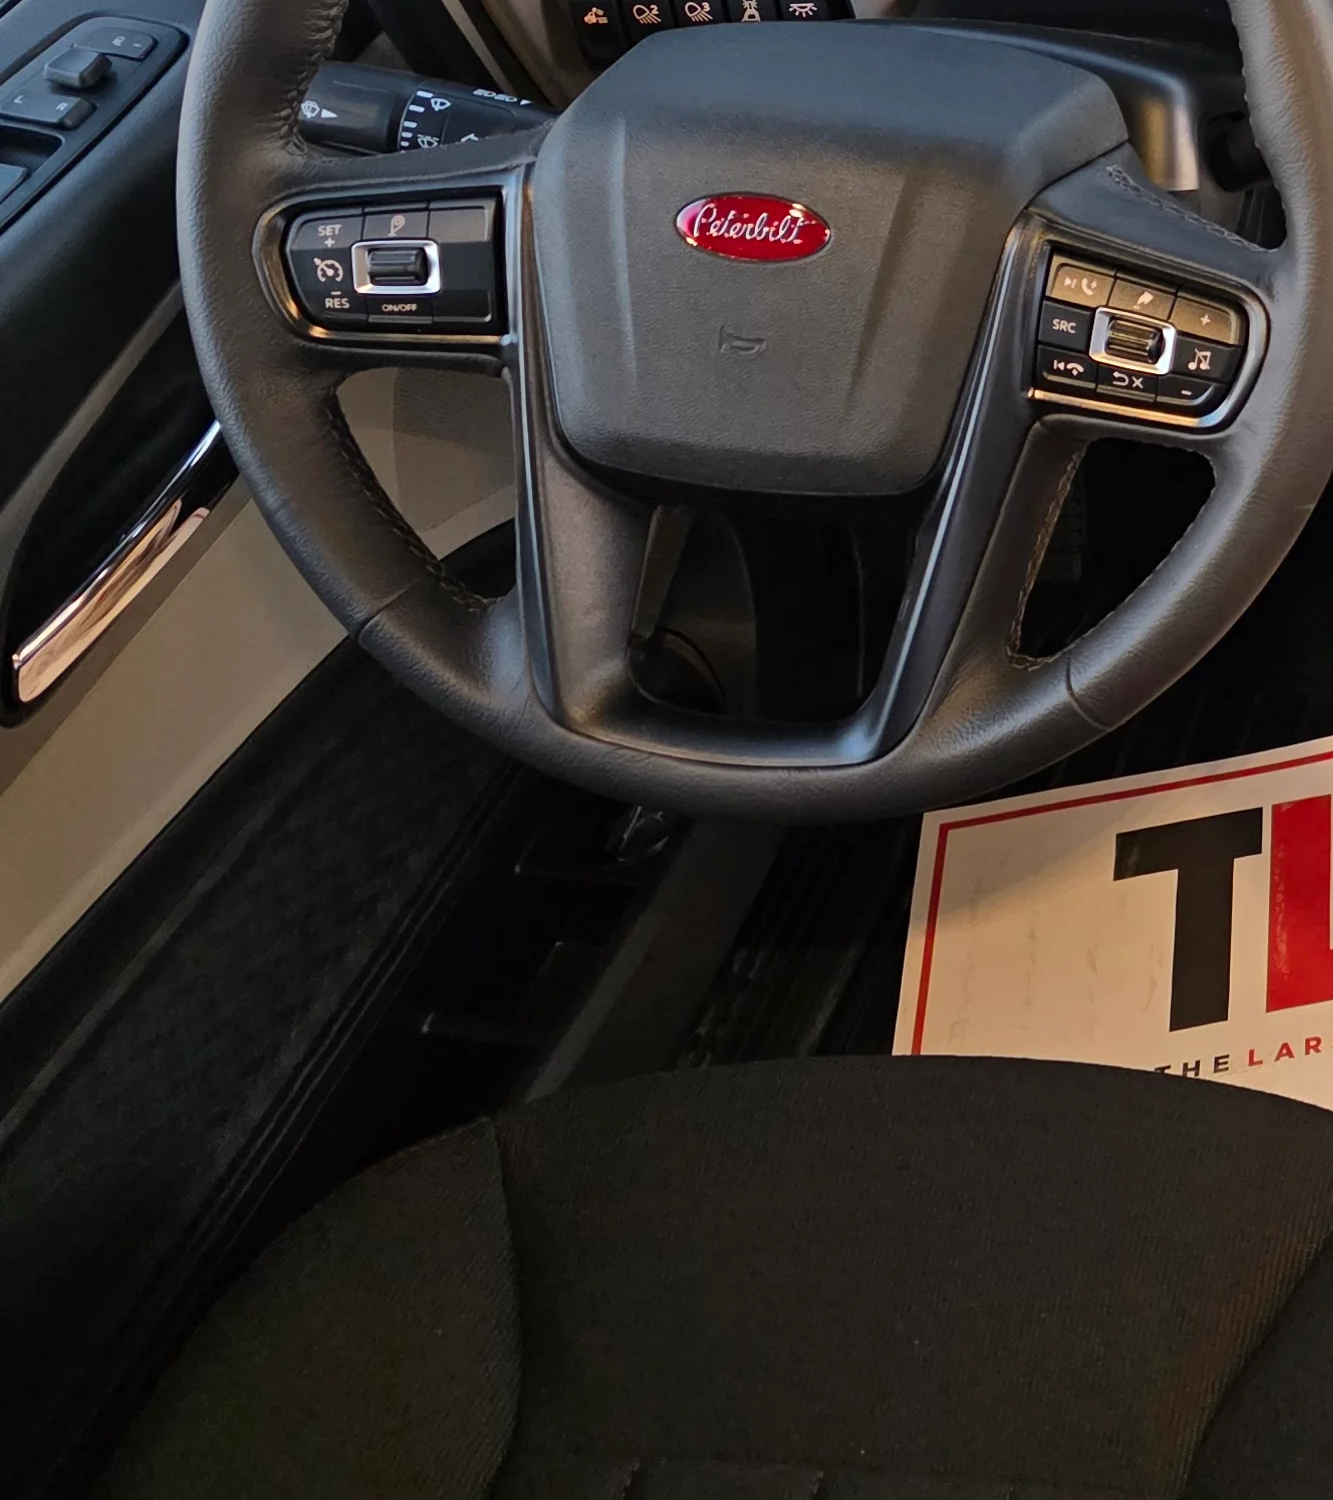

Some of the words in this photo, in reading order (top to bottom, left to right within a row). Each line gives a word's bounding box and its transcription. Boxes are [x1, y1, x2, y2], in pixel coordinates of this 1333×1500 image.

[693, 203, 816, 244] Peterbilt
[317, 224, 342, 237] SET
[325, 298, 350, 310] RES
[381, 303, 417, 312] ON/OFF
[1052, 318, 1077, 334] SRC
